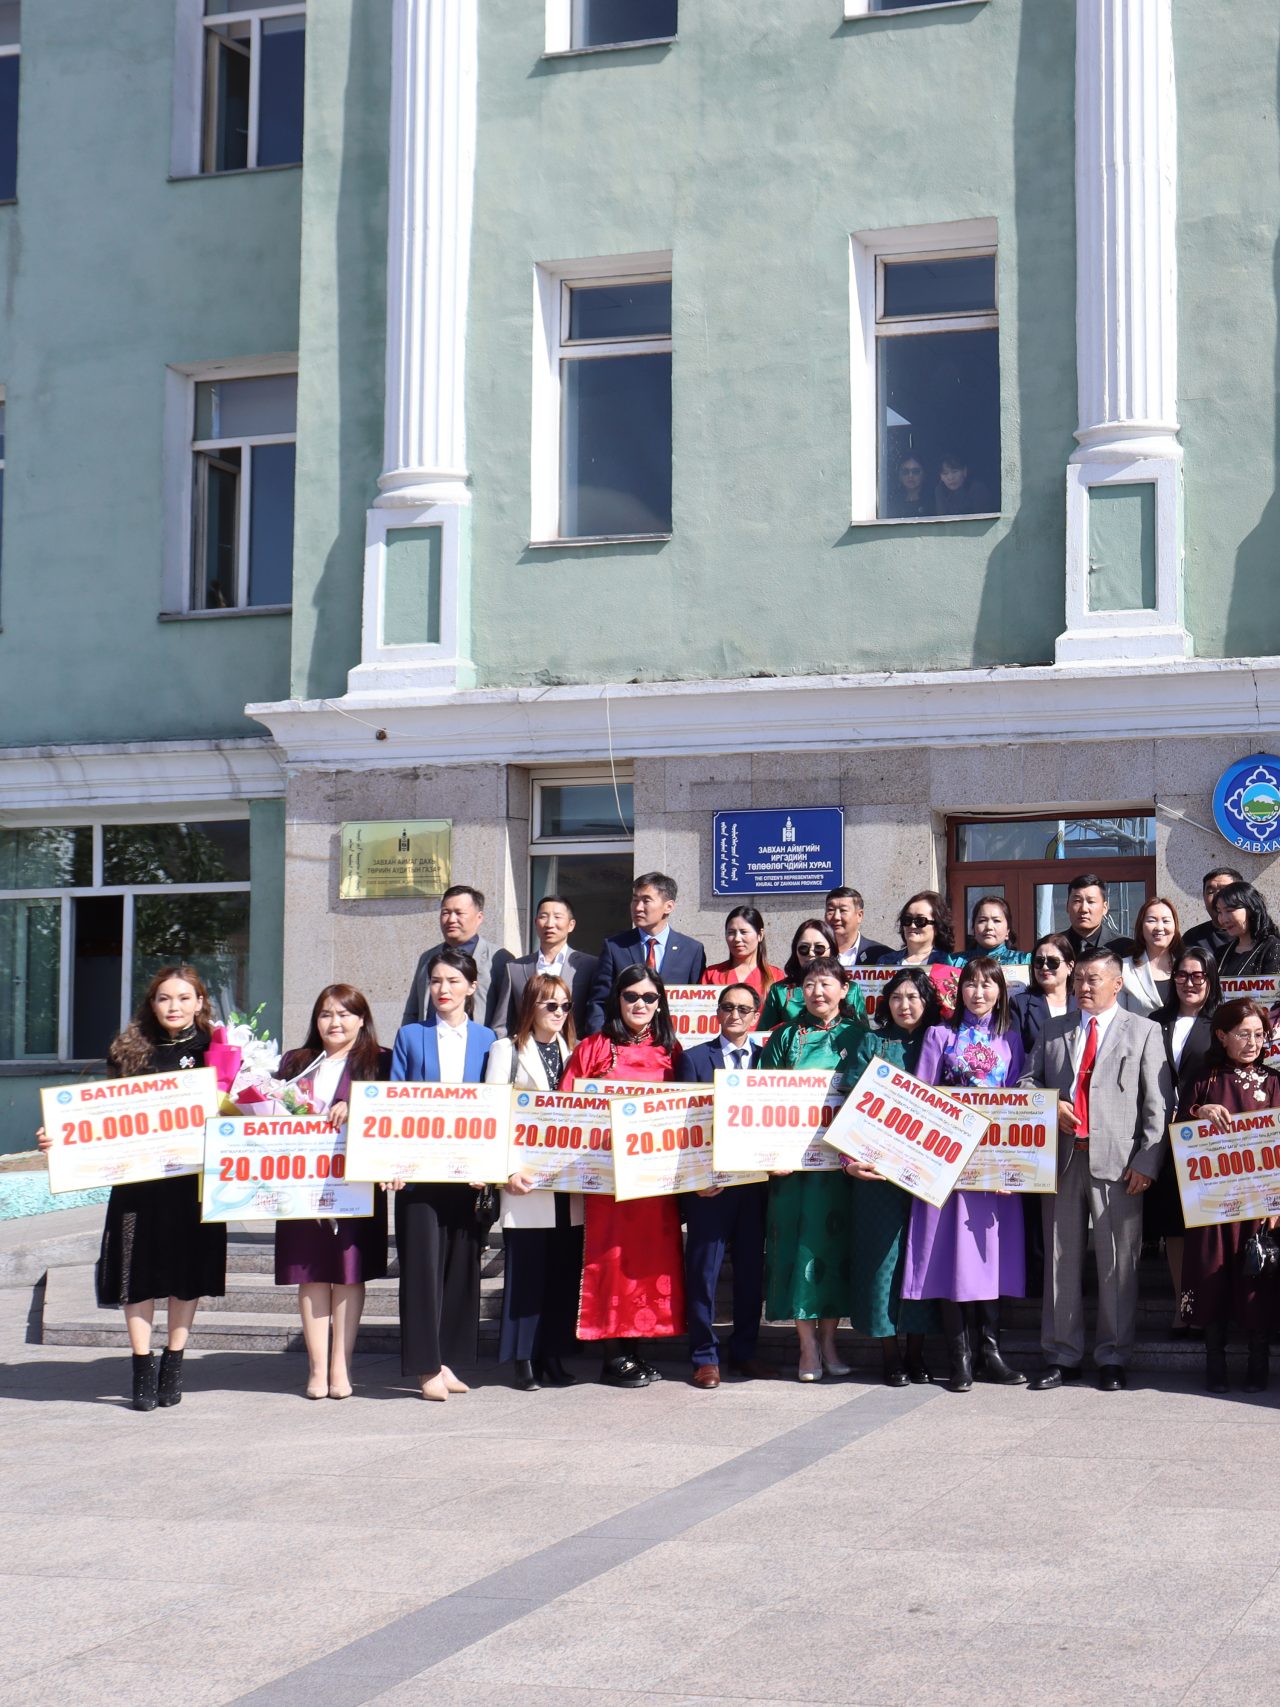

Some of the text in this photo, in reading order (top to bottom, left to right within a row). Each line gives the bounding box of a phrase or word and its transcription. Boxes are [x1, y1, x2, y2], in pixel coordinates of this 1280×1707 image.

[758, 844, 820, 854] ЗАВХАН АЙМГИЙН
[748, 861, 831, 870] ТӨЛӨӨЛӨГЧДИЙН ХУРАЛ
[771, 854, 808, 862] ИРГЭДИЙН
[844, 970, 896, 980] БАТЛАМ
[1220, 979, 1275, 992] ТЛАМЖ
[664, 990, 716, 1000] ТЛАМЖ
[80, 1078, 178, 1102] БАТЛАМЖ
[746, 1076, 827, 1088] БАТЛАМЖ
[386, 1086, 478, 1100] БАТЛАМЖ
[891, 1074, 964, 1120] БАТЛАМЖ
[535, 1095, 610, 1110] БАТЛАМЖ
[644, 1094, 714, 1114] БАТЛАМ
[62, 1104, 205, 1146] 20.000.000
[362, 1116, 496, 1140] 20.000.000
[856, 1092, 962, 1164] 20.000.000
[514, 1124, 612, 1150] 20.000.00
[626, 1125, 714, 1156] 20.000.
[220, 1154, 346, 1182] 20.000.00
